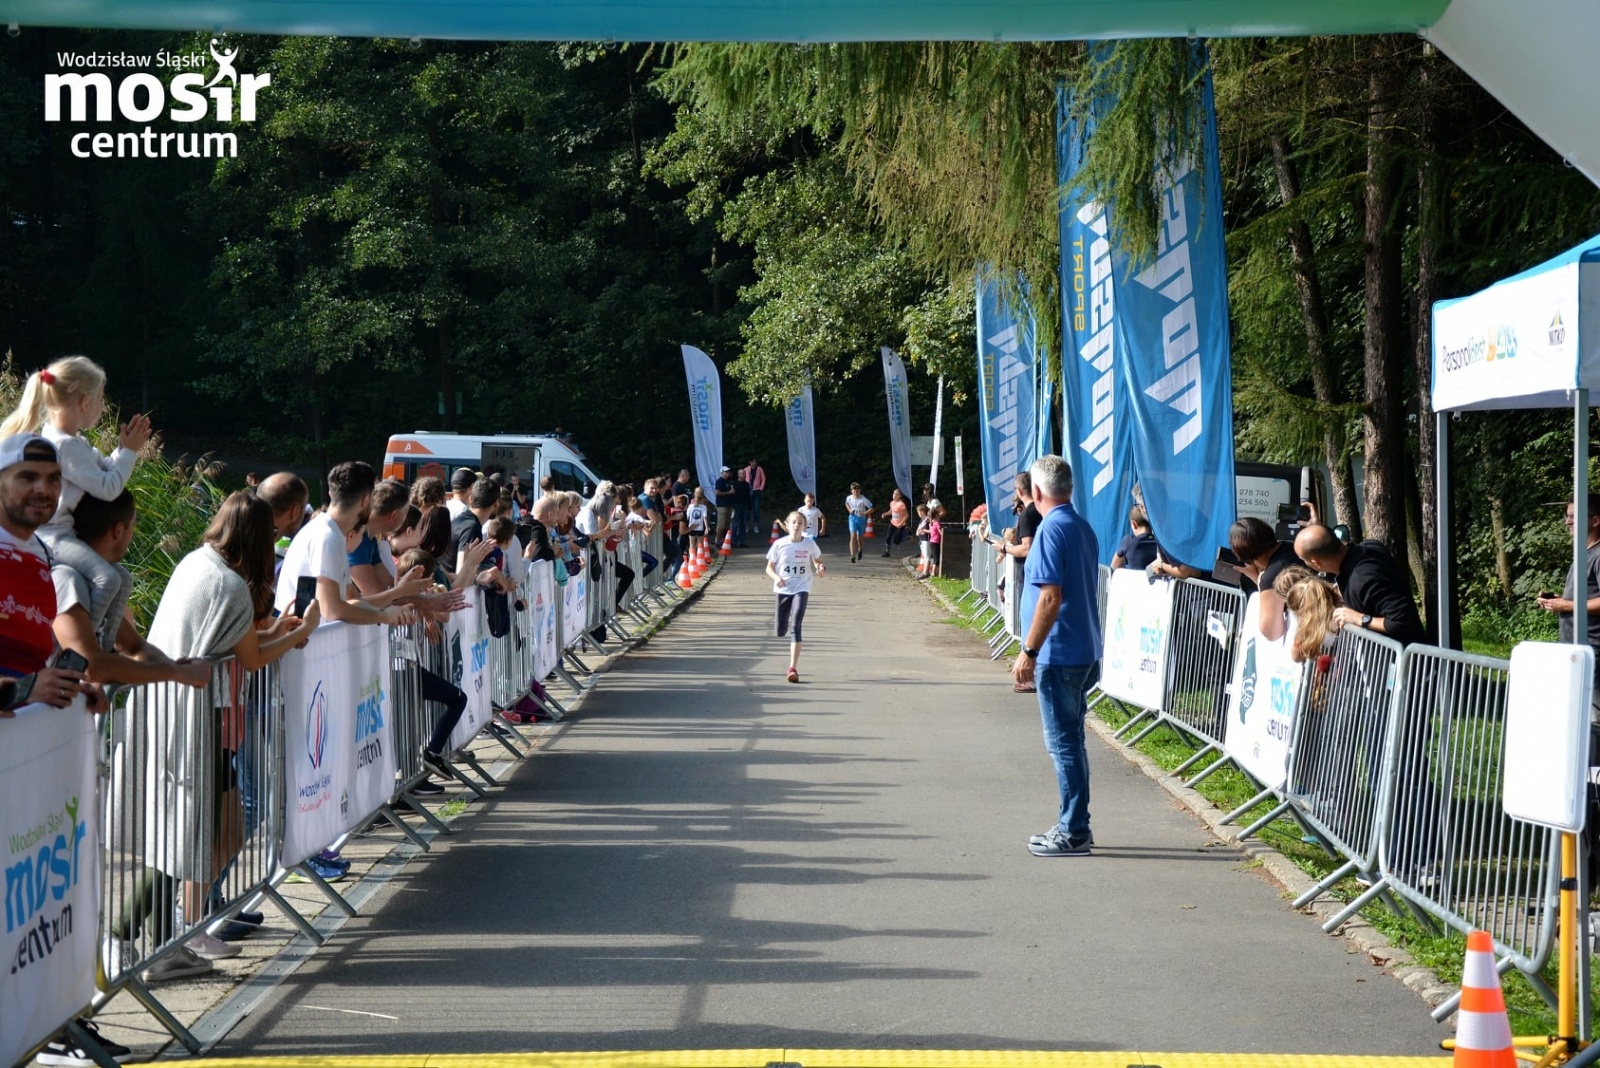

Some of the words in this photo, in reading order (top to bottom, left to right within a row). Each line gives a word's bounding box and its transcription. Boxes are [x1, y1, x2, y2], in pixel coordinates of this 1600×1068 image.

[404, 442, 412, 452] A
[1239, 489, 1253, 497] 278
[1255, 490, 1269, 498] 740
[1238, 498, 1252, 506] 234
[784, 565, 806, 575] 415
